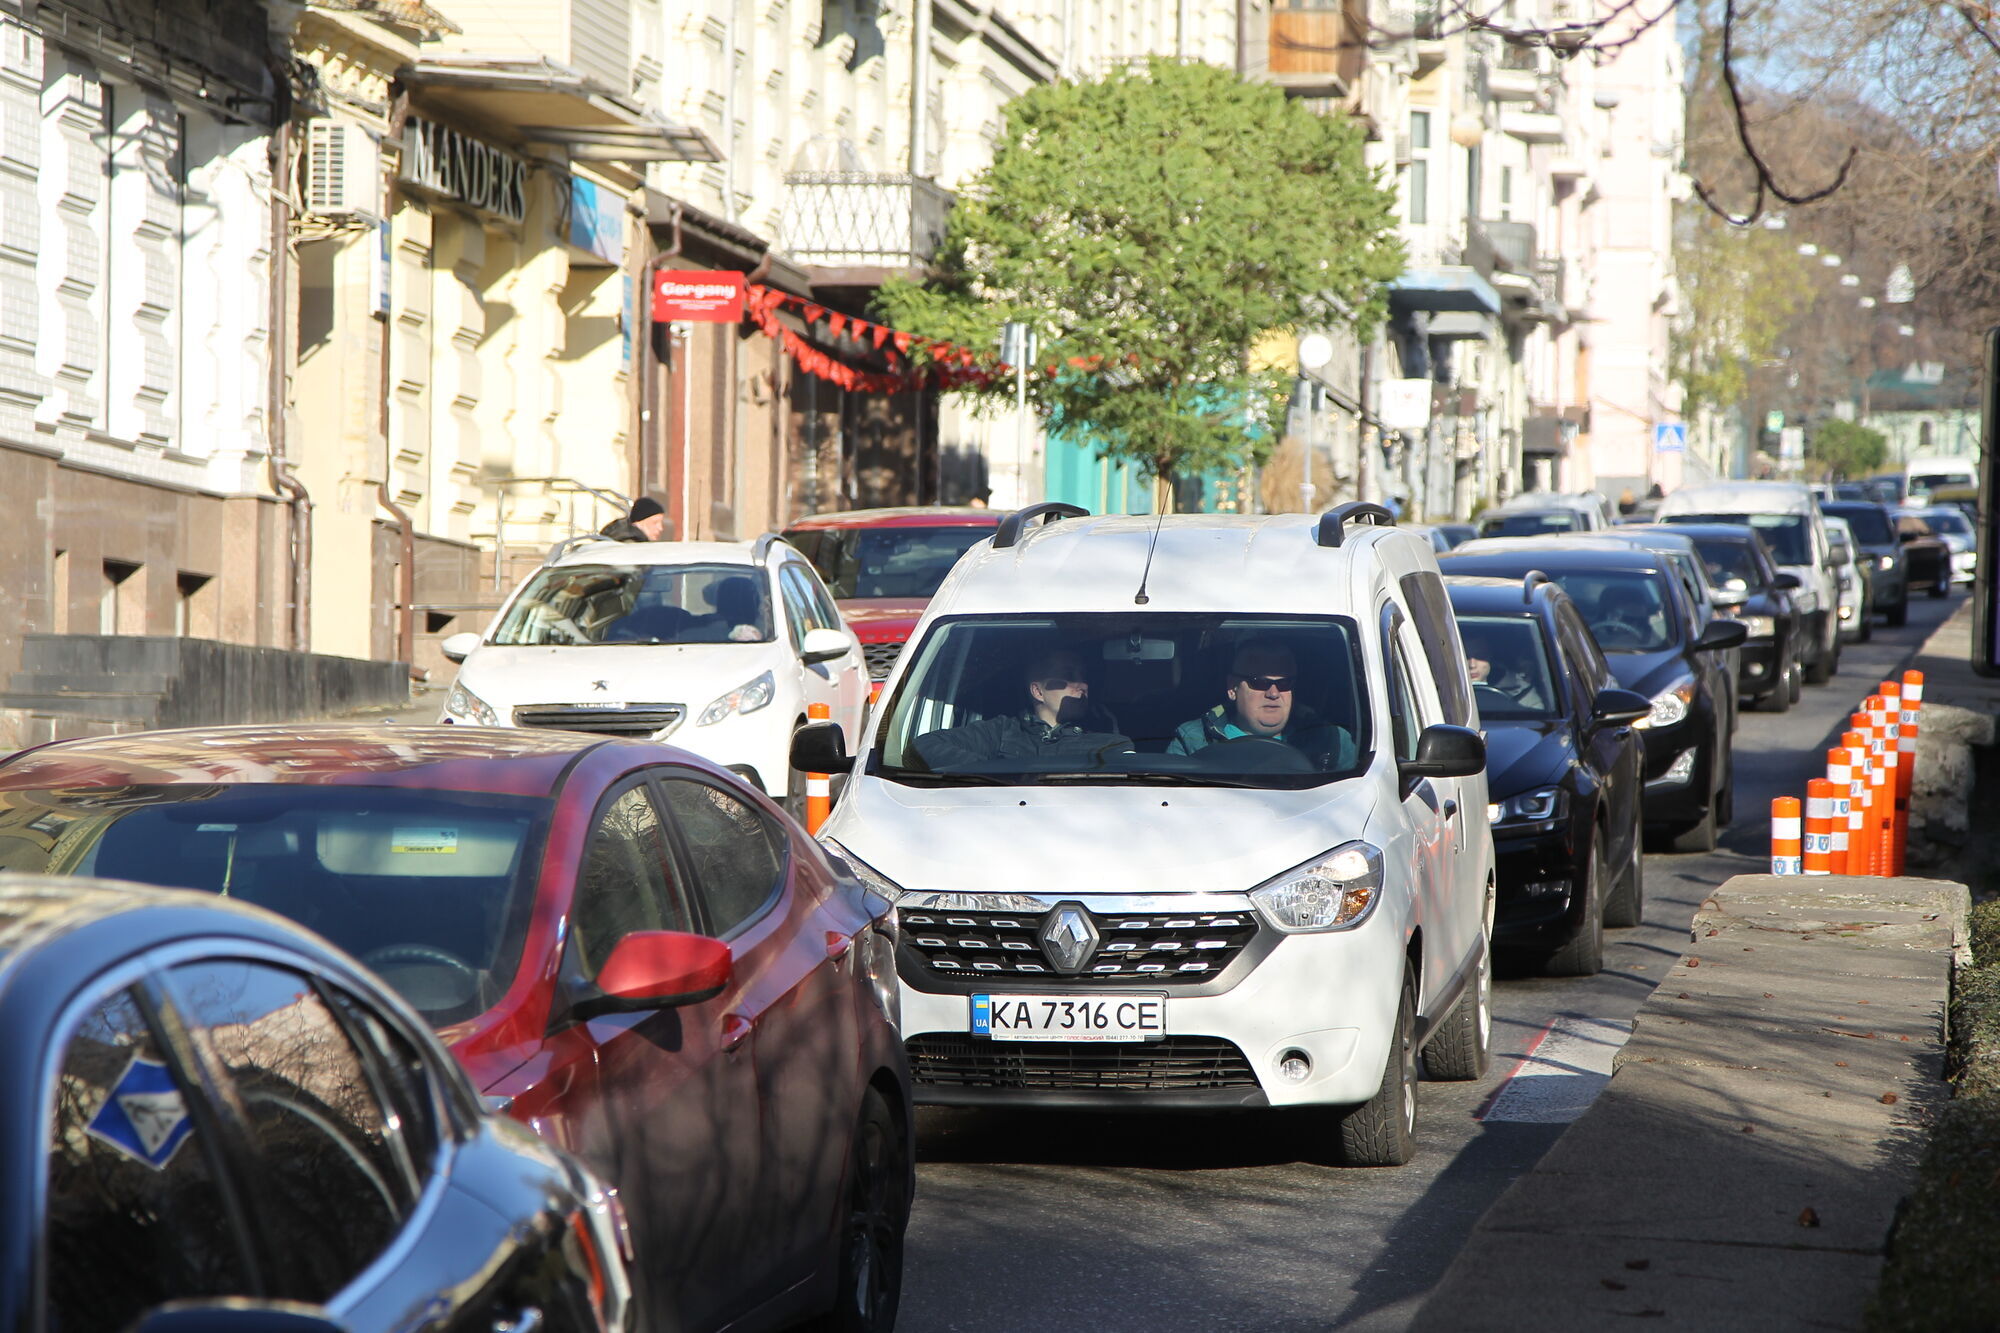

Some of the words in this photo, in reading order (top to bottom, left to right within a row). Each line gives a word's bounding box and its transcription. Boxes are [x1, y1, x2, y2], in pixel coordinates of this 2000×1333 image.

[411, 117, 527, 225] MANDERS
[975, 1018, 988, 1028] UA
[991, 1001, 1033, 1029] KA
[1041, 1001, 1109, 1029] 7316
[1116, 1002, 1159, 1030] CE
